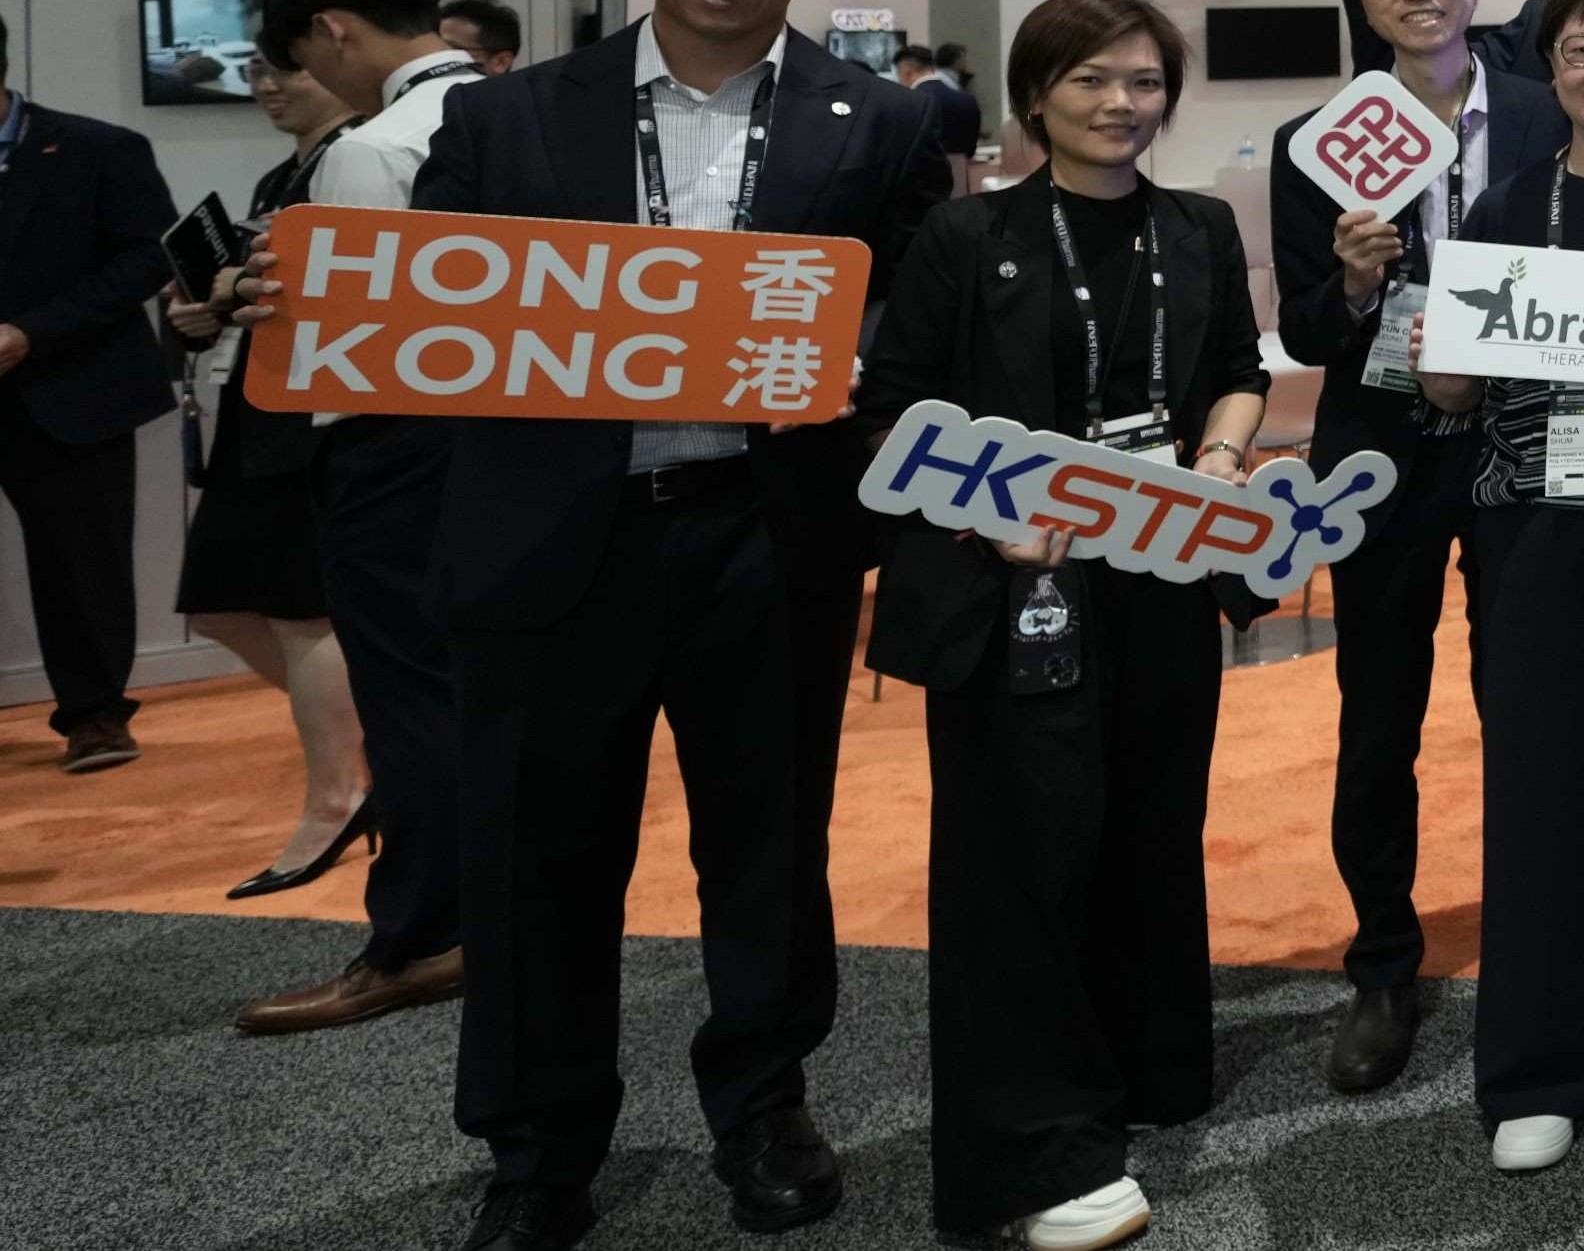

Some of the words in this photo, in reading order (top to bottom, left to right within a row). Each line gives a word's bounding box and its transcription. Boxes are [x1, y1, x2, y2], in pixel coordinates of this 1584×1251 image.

[302, 227, 703, 315] HONG
[286, 320, 688, 402] KONG
[1550, 427, 1580, 436] ALISA
[888, 423, 1273, 565] HKSTP
